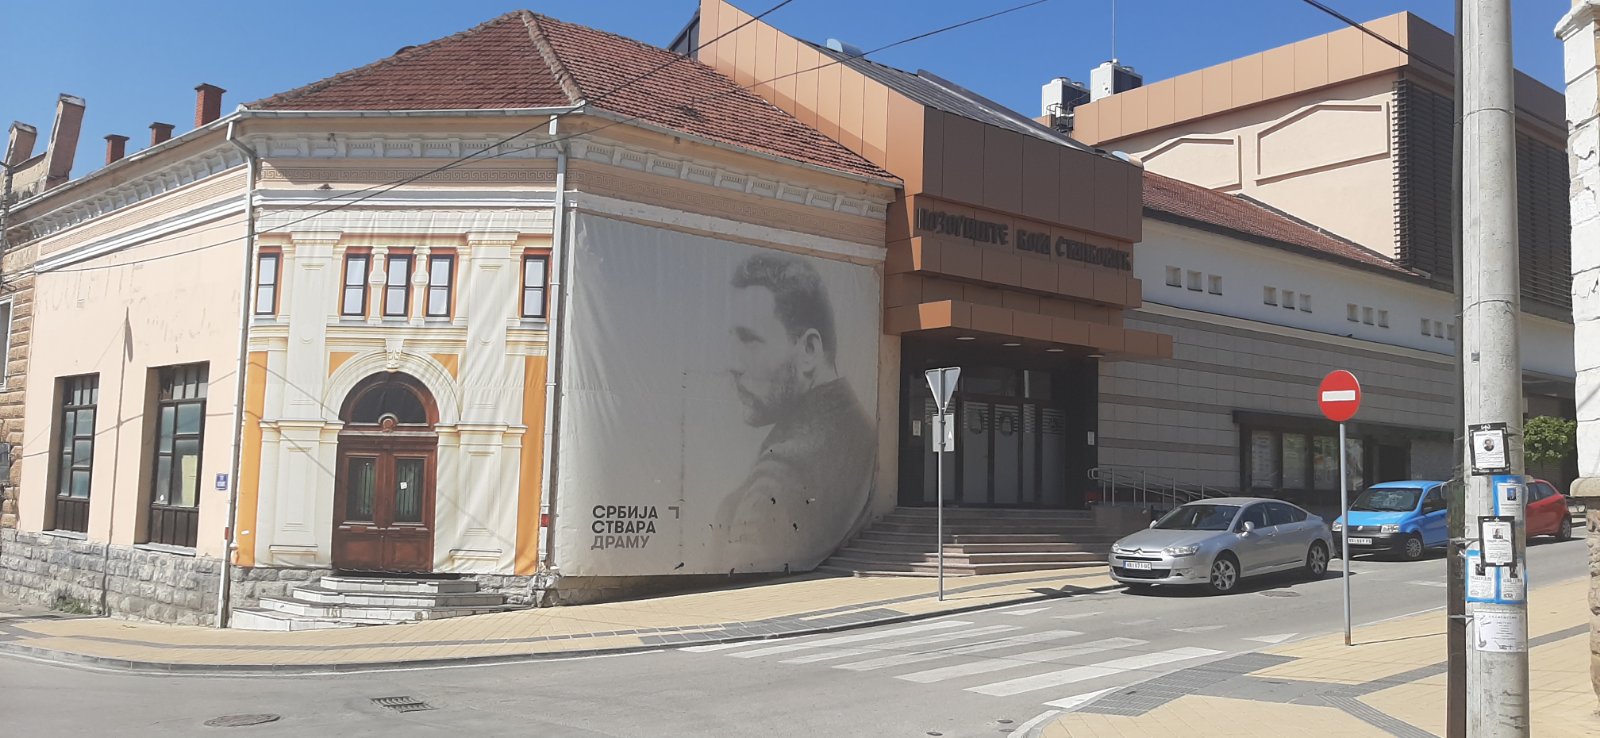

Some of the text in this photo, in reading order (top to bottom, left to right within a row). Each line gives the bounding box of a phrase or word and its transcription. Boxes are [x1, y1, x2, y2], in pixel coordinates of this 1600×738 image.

[592, 504, 659, 519] СРБИЈА
[591, 520, 657, 534] СТВАРА
[590, 535, 650, 551] ДРАМУ
